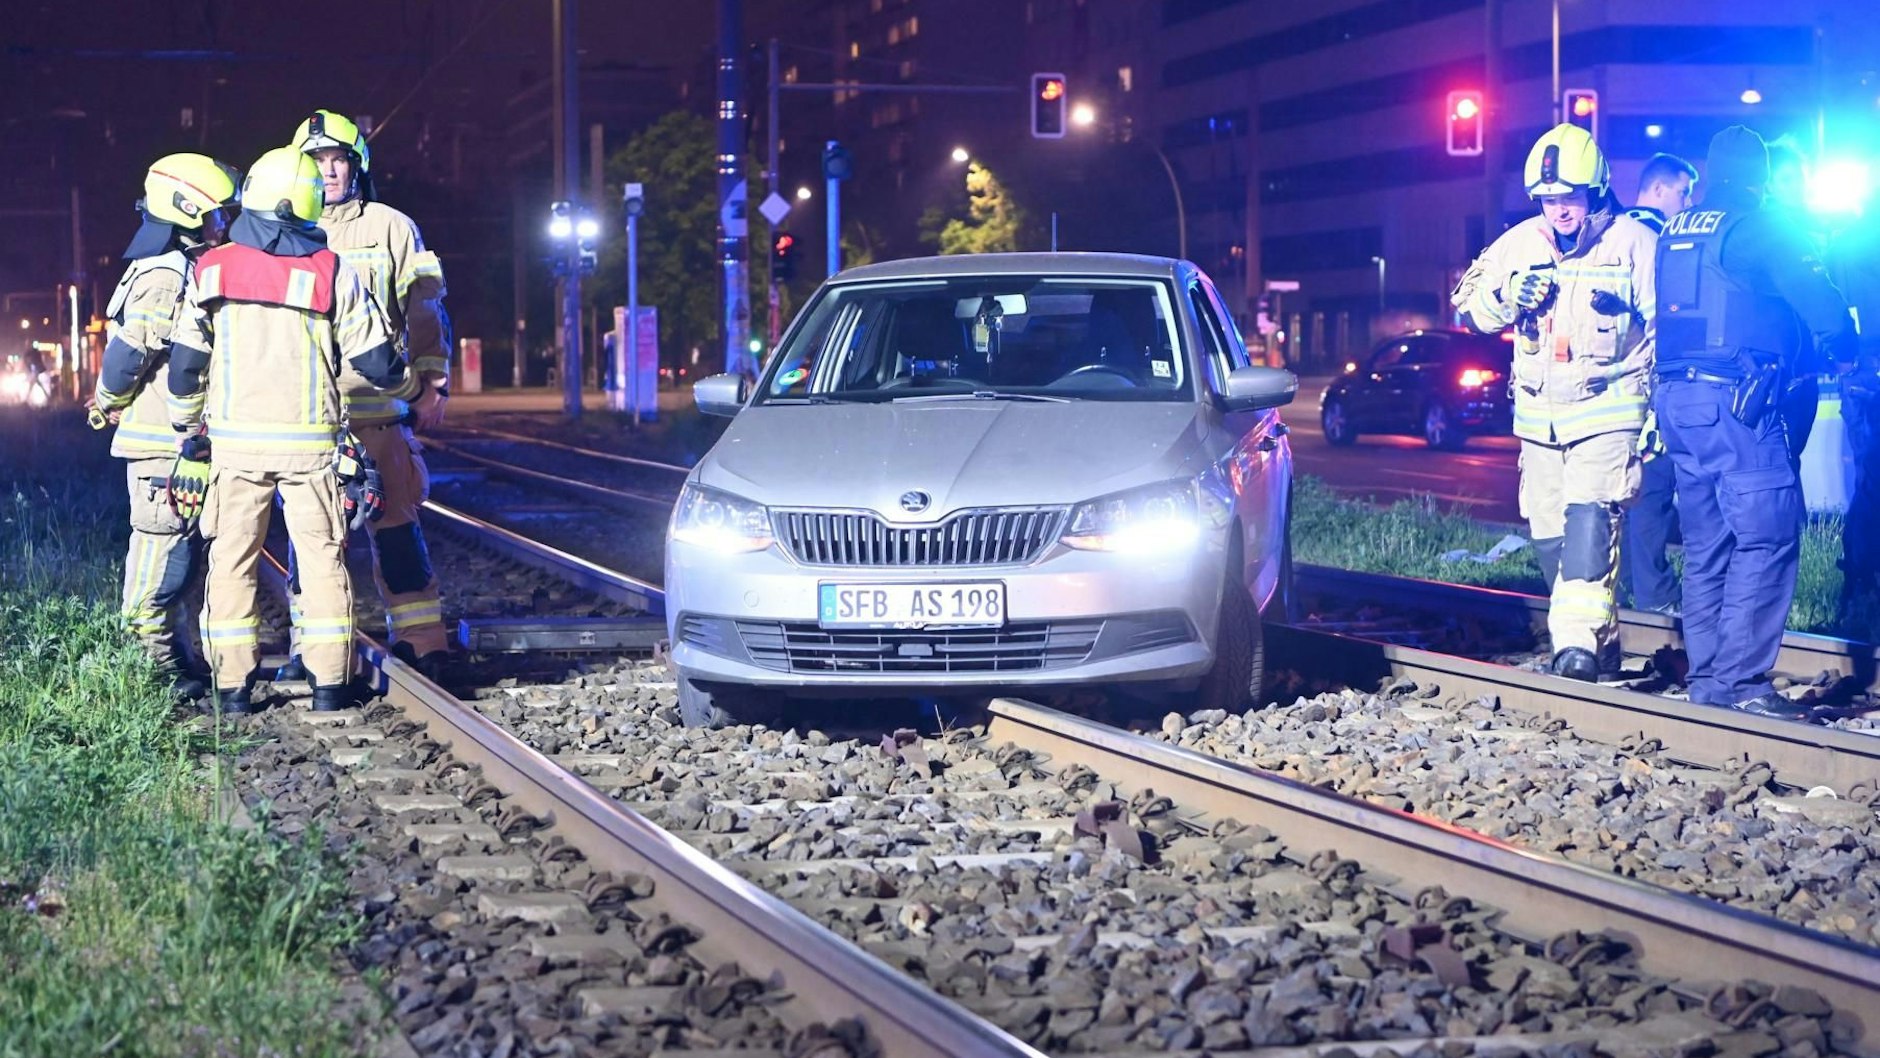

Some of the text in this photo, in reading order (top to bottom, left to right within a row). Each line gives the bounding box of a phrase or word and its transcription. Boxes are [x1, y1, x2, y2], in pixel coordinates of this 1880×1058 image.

[1660, 211, 1726, 237] POLIZEI
[839, 589, 999, 618] SFB AS 198
